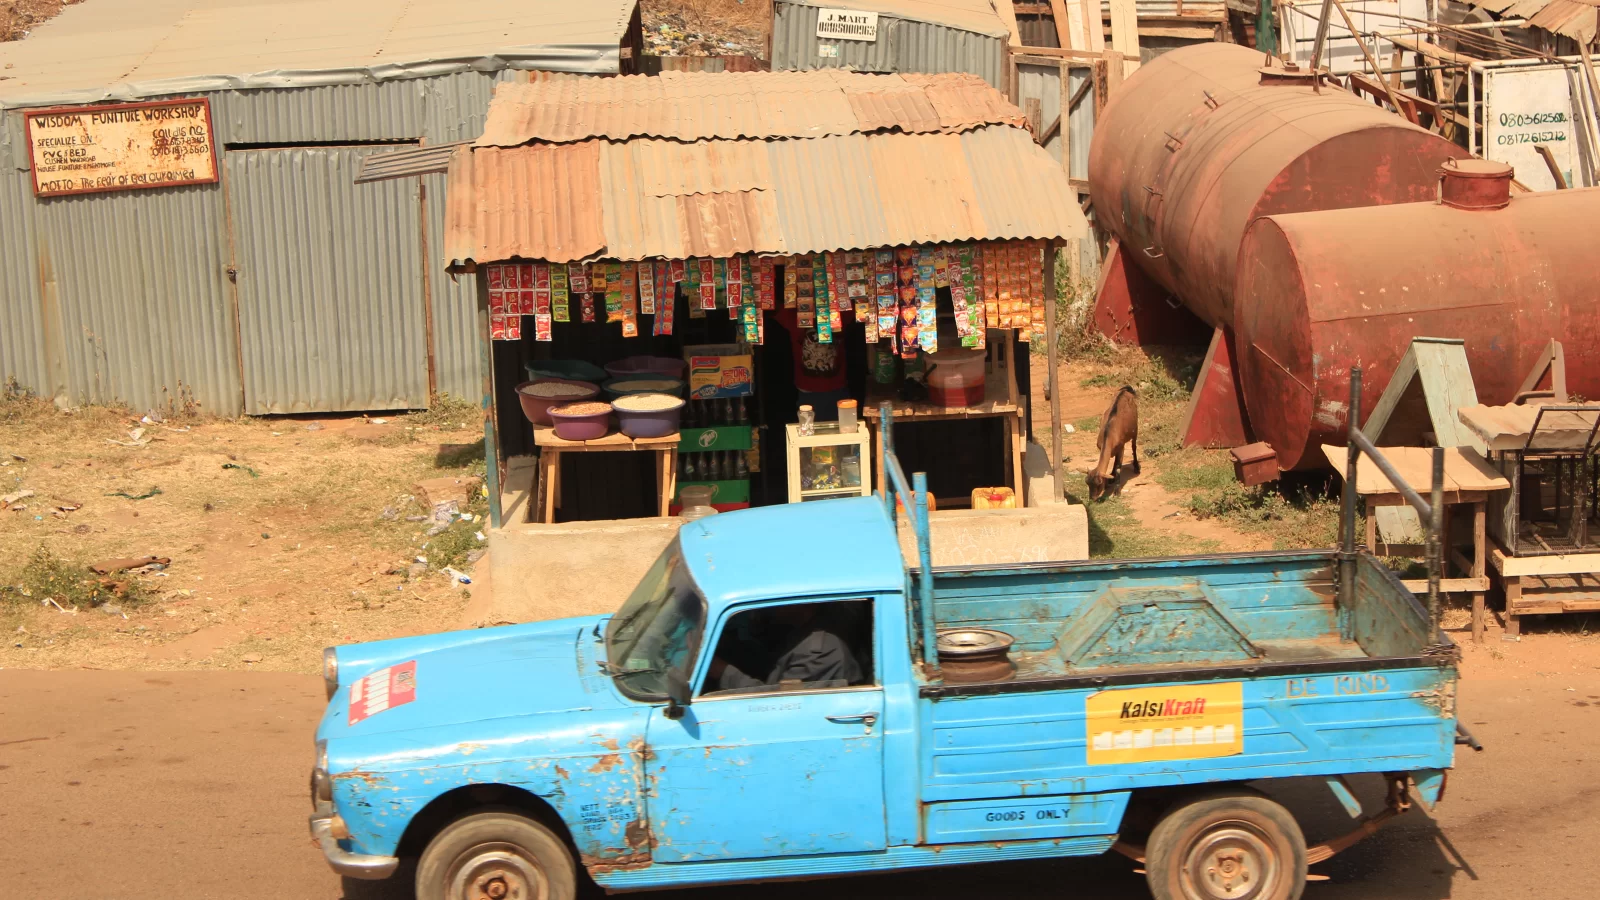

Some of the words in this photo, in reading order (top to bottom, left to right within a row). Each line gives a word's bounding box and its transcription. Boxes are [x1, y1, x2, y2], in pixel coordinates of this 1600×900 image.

[838, 14, 868, 24] MART
[34, 115, 82, 128] WISDOM
[92, 109, 140, 125] FUNITURE
[143, 105, 201, 121] WORKSHOP
[37, 136, 76, 147] SPECIALIZE
[80, 135, 92, 144] ON
[43, 150, 62, 158] PVC
[69, 148, 87, 157] BED
[40, 179, 74, 191] MOTTO
[1286, 677, 1318, 699] BE
[1120, 697, 1206, 719] KalsiKraft
[985, 810, 1025, 822] GOODS
[1036, 808, 1071, 820] ONLY
